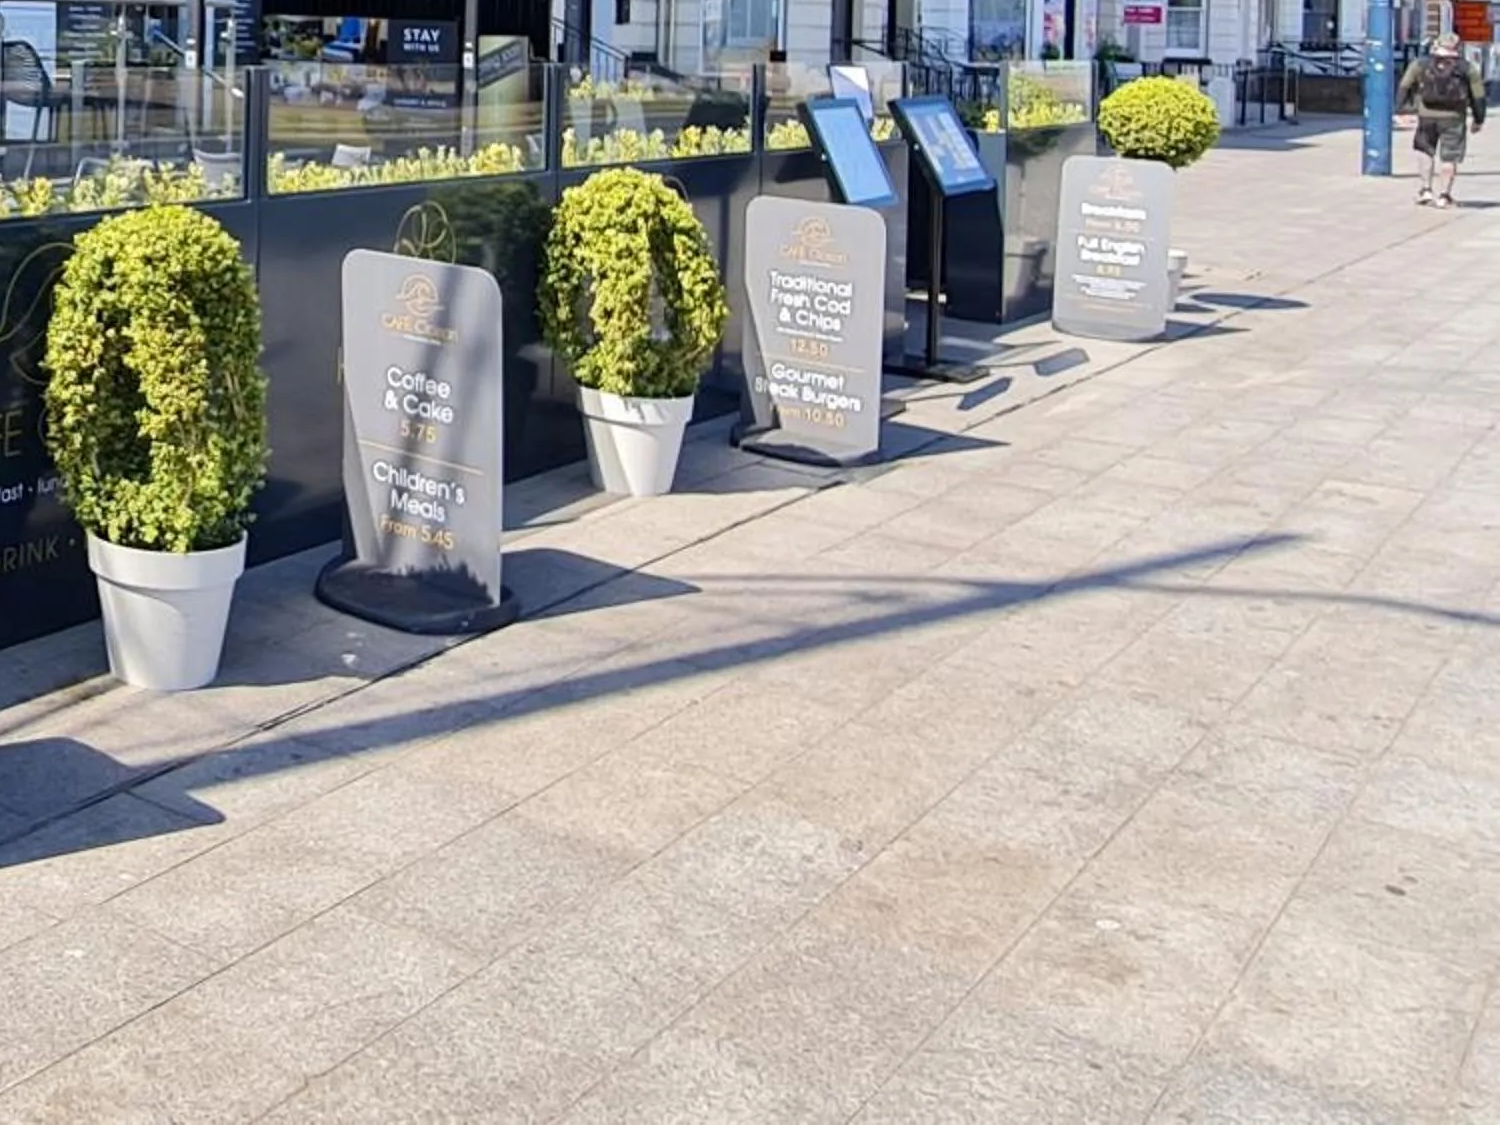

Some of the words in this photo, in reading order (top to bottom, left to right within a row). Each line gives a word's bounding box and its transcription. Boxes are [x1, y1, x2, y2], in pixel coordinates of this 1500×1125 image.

[403, 28, 440, 42] STAY
[770, 270, 853, 298] Traditional
[770, 287, 811, 309] Fresh
[813, 294, 851, 316] Cod
[778, 306, 791, 323] &
[795, 308, 842, 333] Chips
[386, 366, 451, 400] Coffee
[771, 362, 845, 392] Gourmet
[384, 389, 398, 411] &
[403, 394, 454, 425] Cake
[801, 385, 861, 412] Burgers
[373, 461, 465, 506] Children's
[391, 488, 445, 523] Meals
[381, 514, 417, 540] From
[421, 525, 454, 551] 5.45
